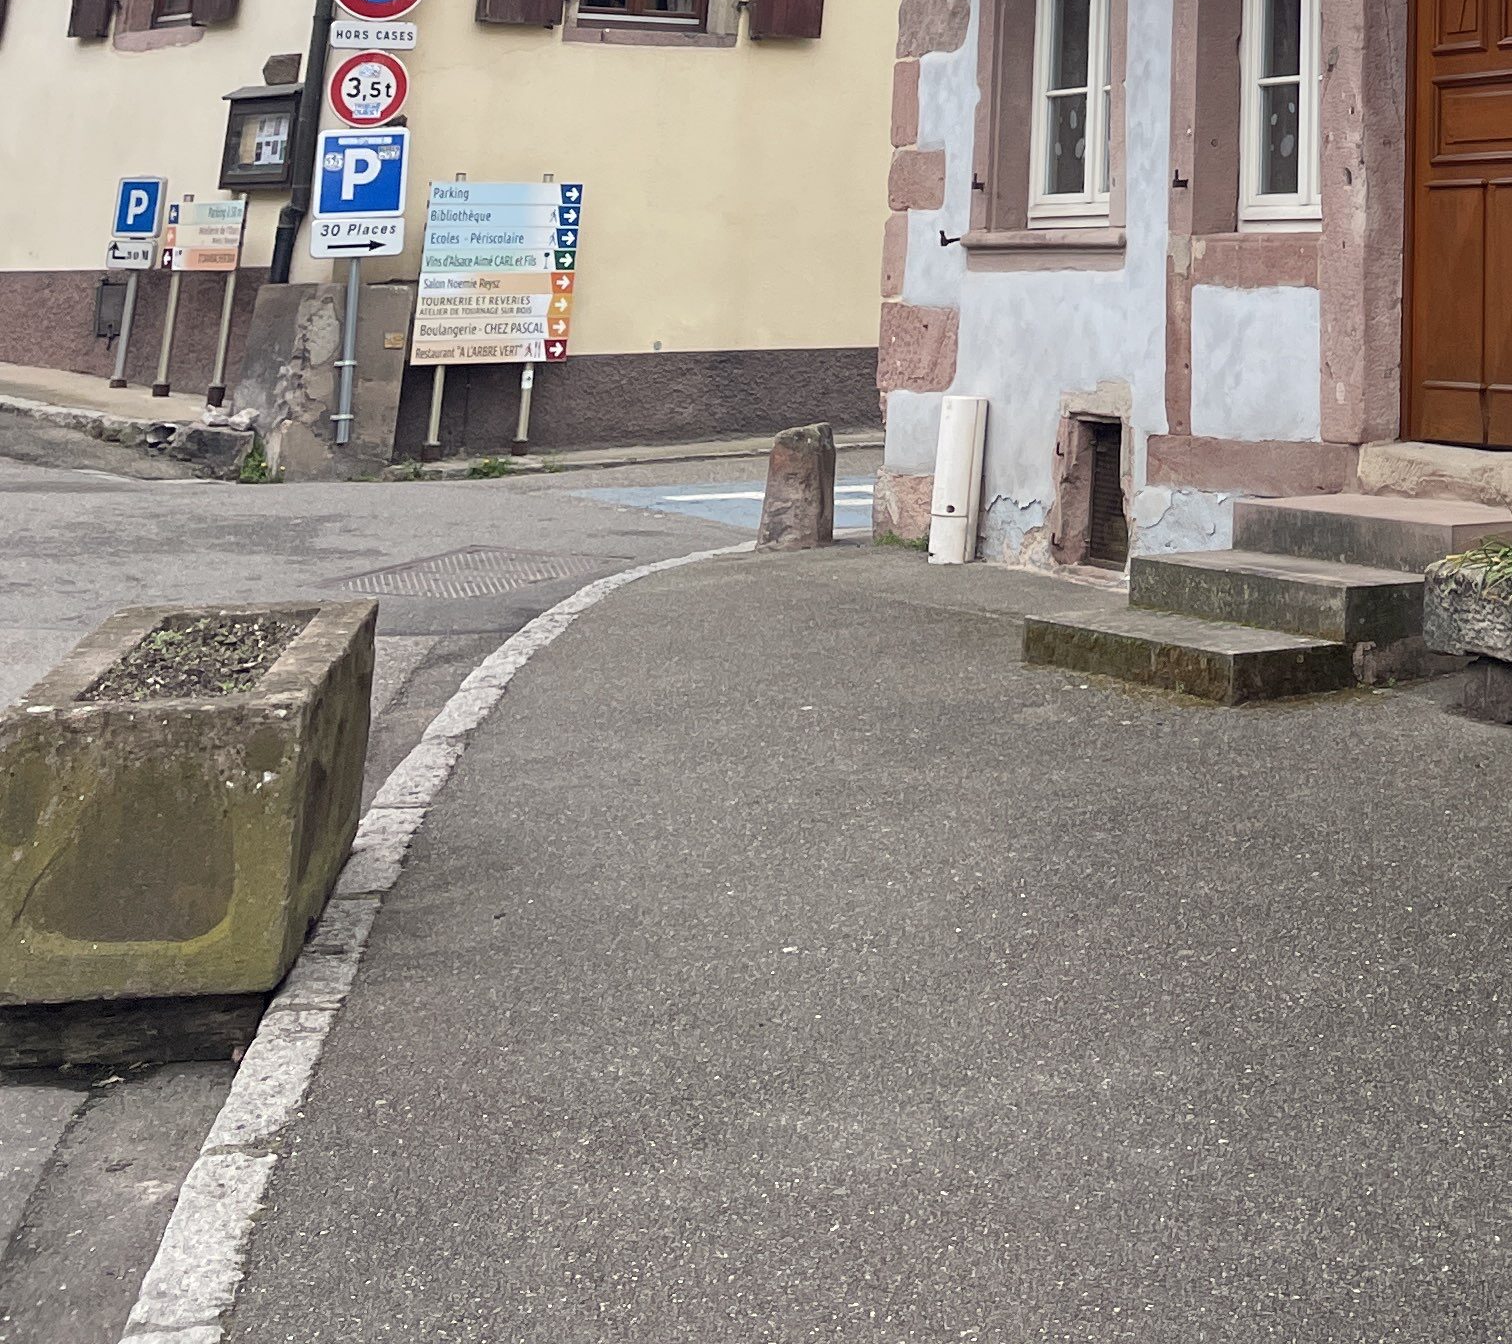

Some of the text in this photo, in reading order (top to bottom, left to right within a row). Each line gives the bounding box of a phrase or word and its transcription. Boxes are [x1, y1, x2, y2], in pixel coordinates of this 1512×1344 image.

[336, 30, 413, 41] HORS CASES
[341, 147, 381, 200] P
[433, 187, 469, 201] Parking
[126, 189, 149, 224] P
[430, 209, 492, 224] Bibliothèque
[320, 223, 397, 236] 30 Places
[430, 233, 460, 245] Ecoles
[470, 232, 525, 244] Périscolaire
[426, 255, 442, 267] Vins
[443, 254, 472, 267] d'Alsace
[494, 255, 513, 266] CARL
[515, 256, 523, 266] et
[424, 278, 445, 289] Salon
[478, 278, 501, 291] Reysz
[421, 296, 473, 306] TOURNERIE
[475, 296, 486, 305] ET
[419, 307, 448, 316] ATELIER
[420, 323, 477, 338] Boulangerie
[484, 322, 509, 334] CHEZ
[511, 322, 544, 334] PASCAL
[415, 347, 455, 359] Restaurant
